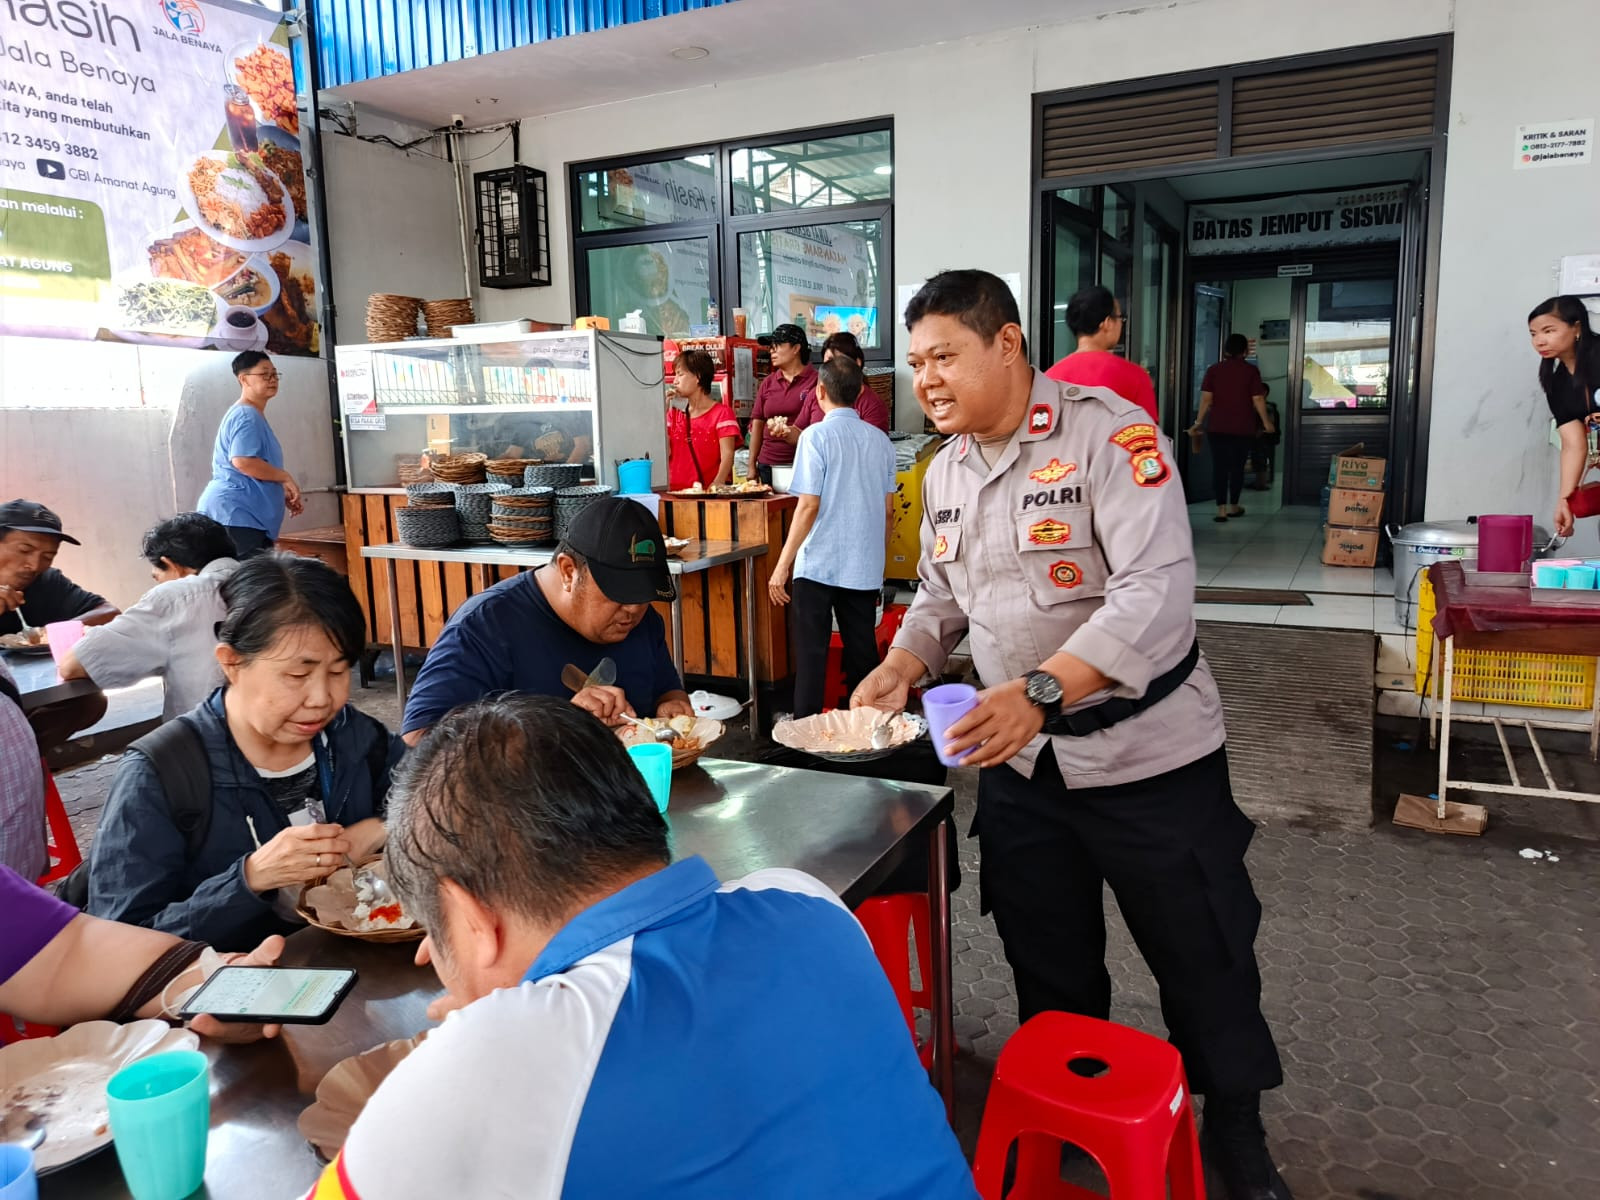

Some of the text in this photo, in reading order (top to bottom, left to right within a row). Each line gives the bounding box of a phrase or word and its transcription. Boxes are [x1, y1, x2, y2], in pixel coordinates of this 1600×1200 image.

[153, 26, 222, 53] JALA BENAYA
[61, 50, 156, 95] Benaya
[45, 90, 78, 106] anda
[81, 96, 113, 113] telah
[0, 99, 151, 141] ita yang membutuhkan
[0, 132, 99, 161] 12 3459 3882
[1523, 132, 1548, 141] KRITIK
[1558, 129, 1586, 138] SARAN
[69, 167, 176, 200] GBI Amanat Agung
[22, 201, 77, 218] melalui
[1192, 217, 1253, 241] BATAS
[1259, 209, 1333, 237] JEMPUT
[21, 257, 73, 273] AGUNG
[705, 343, 725, 351] DULU
[1022, 486, 1081, 510] POLRI
